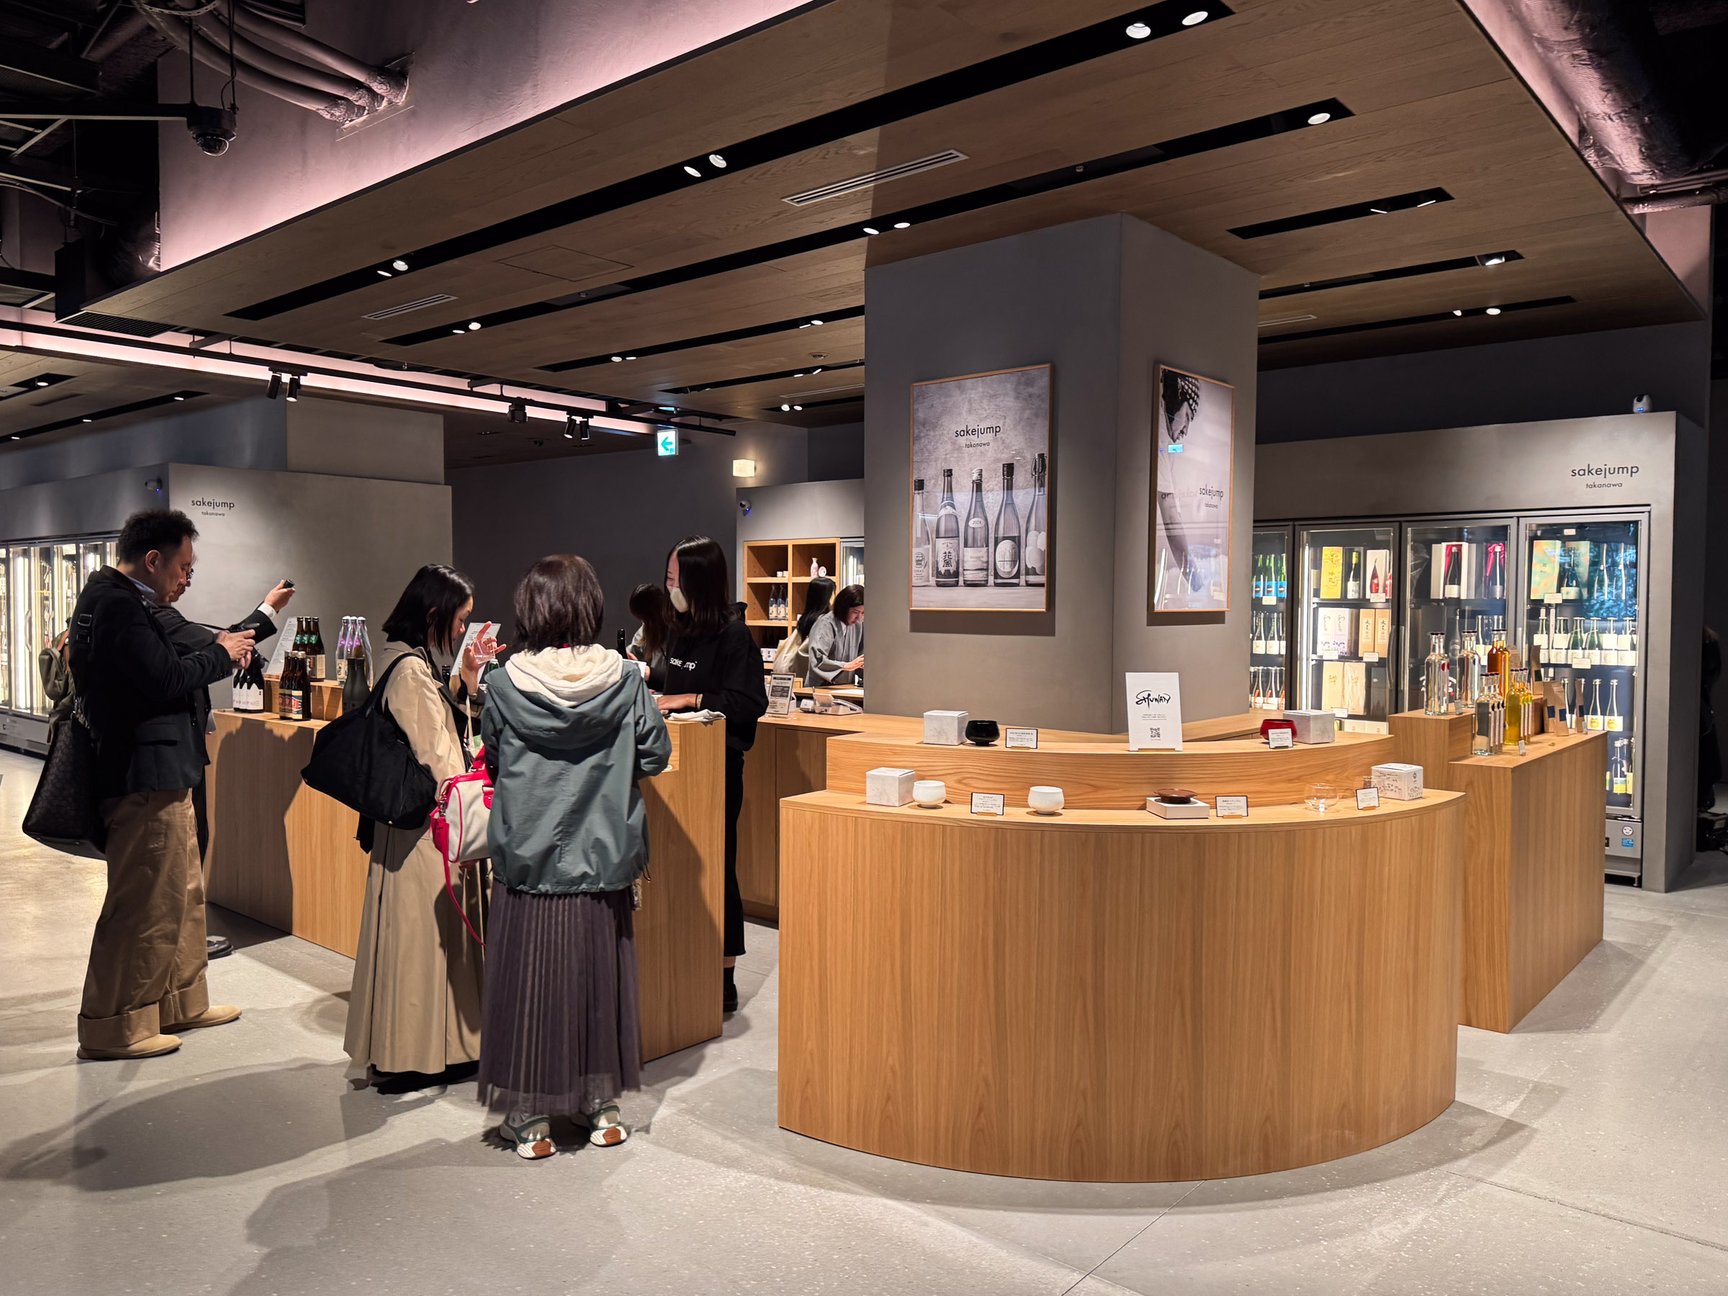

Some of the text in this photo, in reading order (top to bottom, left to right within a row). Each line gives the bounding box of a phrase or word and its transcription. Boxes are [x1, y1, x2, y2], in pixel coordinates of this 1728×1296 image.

[954, 424, 1002, 439] sakejump
[1570, 463, 1640, 479] sakejump
[1199, 483, 1224, 501] sakejump
[1585, 481, 1623, 489] takanawa
[191, 496, 235, 511] sakejump
